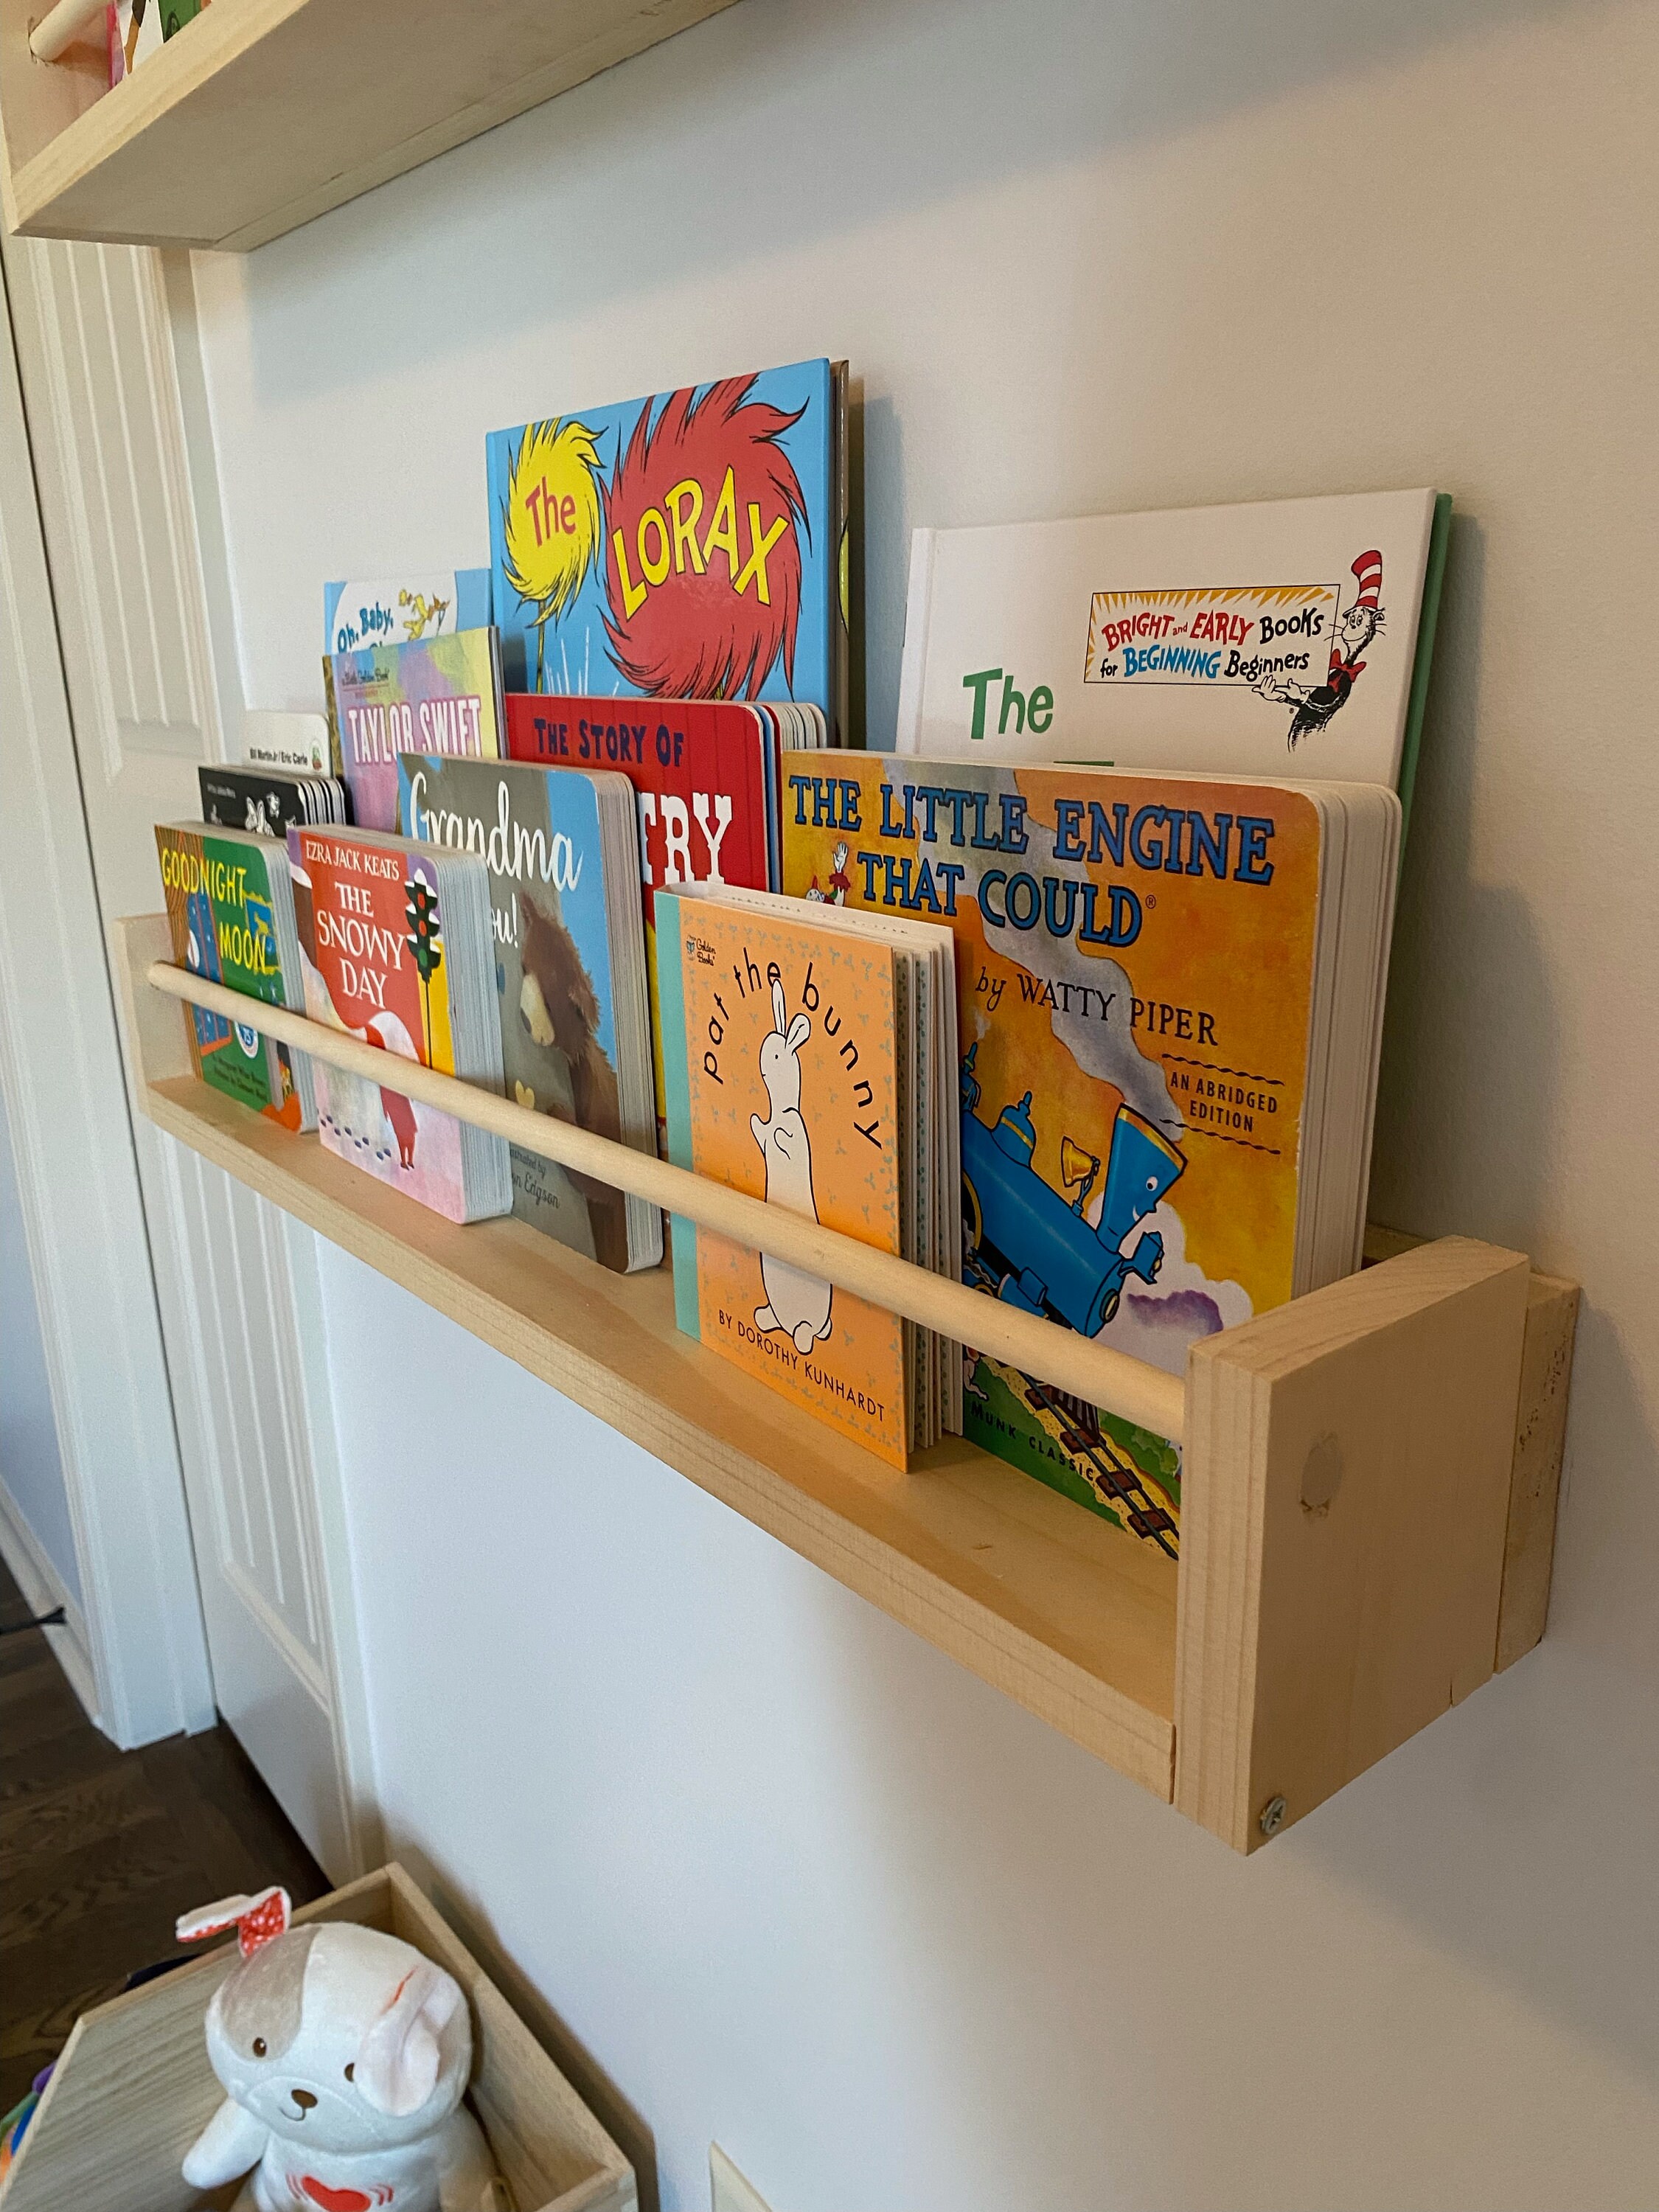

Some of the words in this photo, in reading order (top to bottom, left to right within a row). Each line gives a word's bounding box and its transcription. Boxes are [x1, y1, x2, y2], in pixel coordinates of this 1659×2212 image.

[525, 476, 577, 548] The
[613, 465, 790, 622] LORAX
[360, 601, 394, 636] Baby,
[1102, 612, 1175, 652] BRIGHT
[1172, 622, 1188, 636] and
[1189, 609, 1254, 645] EARLY
[1100, 658, 1118, 678] for
[1122, 644, 1222, 679] BEGINNING
[1223, 649, 1310, 682] Beginners
[347, 704, 415, 763] TAYLOR
[418, 698, 481, 757] SWIFT
[961, 668, 1054, 740] The
[281, 751, 292, 764] Eric
[293, 752, 308, 765] Carle
[410, 771, 583, 892] Grandma
[789, 775, 863, 832] THE
[879, 783, 1030, 855] LITTLE
[1052, 799, 1275, 886] ENGINE
[161, 847, 247, 909] GOODNIGHT
[306, 839, 333, 865] EZRA
[333, 846, 361, 874] JACK
[364, 853, 400, 881] KEATS
[857, 851, 965, 917] THAT
[334, 881, 375, 918] THE
[220, 921, 268, 975] MOON
[317, 909, 406, 971] SNOWY
[696, 938, 717, 955] Golden
[339, 957, 388, 1010] DAY
[975, 967, 1007, 1012] by
[1017, 973, 1116, 1021] WATTY
[1130, 997, 1219, 1046] PIPER
[703, 992, 730, 1085] pat
[733, 947, 782, 998] the
[801, 961, 883, 1150] bunny
[1170, 1071, 1189, 1091] AN
[1195, 1078, 1278, 1114] ABRIDGED
[1189, 1099, 1253, 1133] EDITION
[524, 1171, 560, 1209] Edgson
[538, 1160, 546, 1180] by
[718, 1309, 733, 1329] BY
[737, 1320, 799, 1370] DOROTHY
[804, 1360, 886, 1422] KUNHARDT
[1029, 1436, 1094, 1481] CLASSIC
